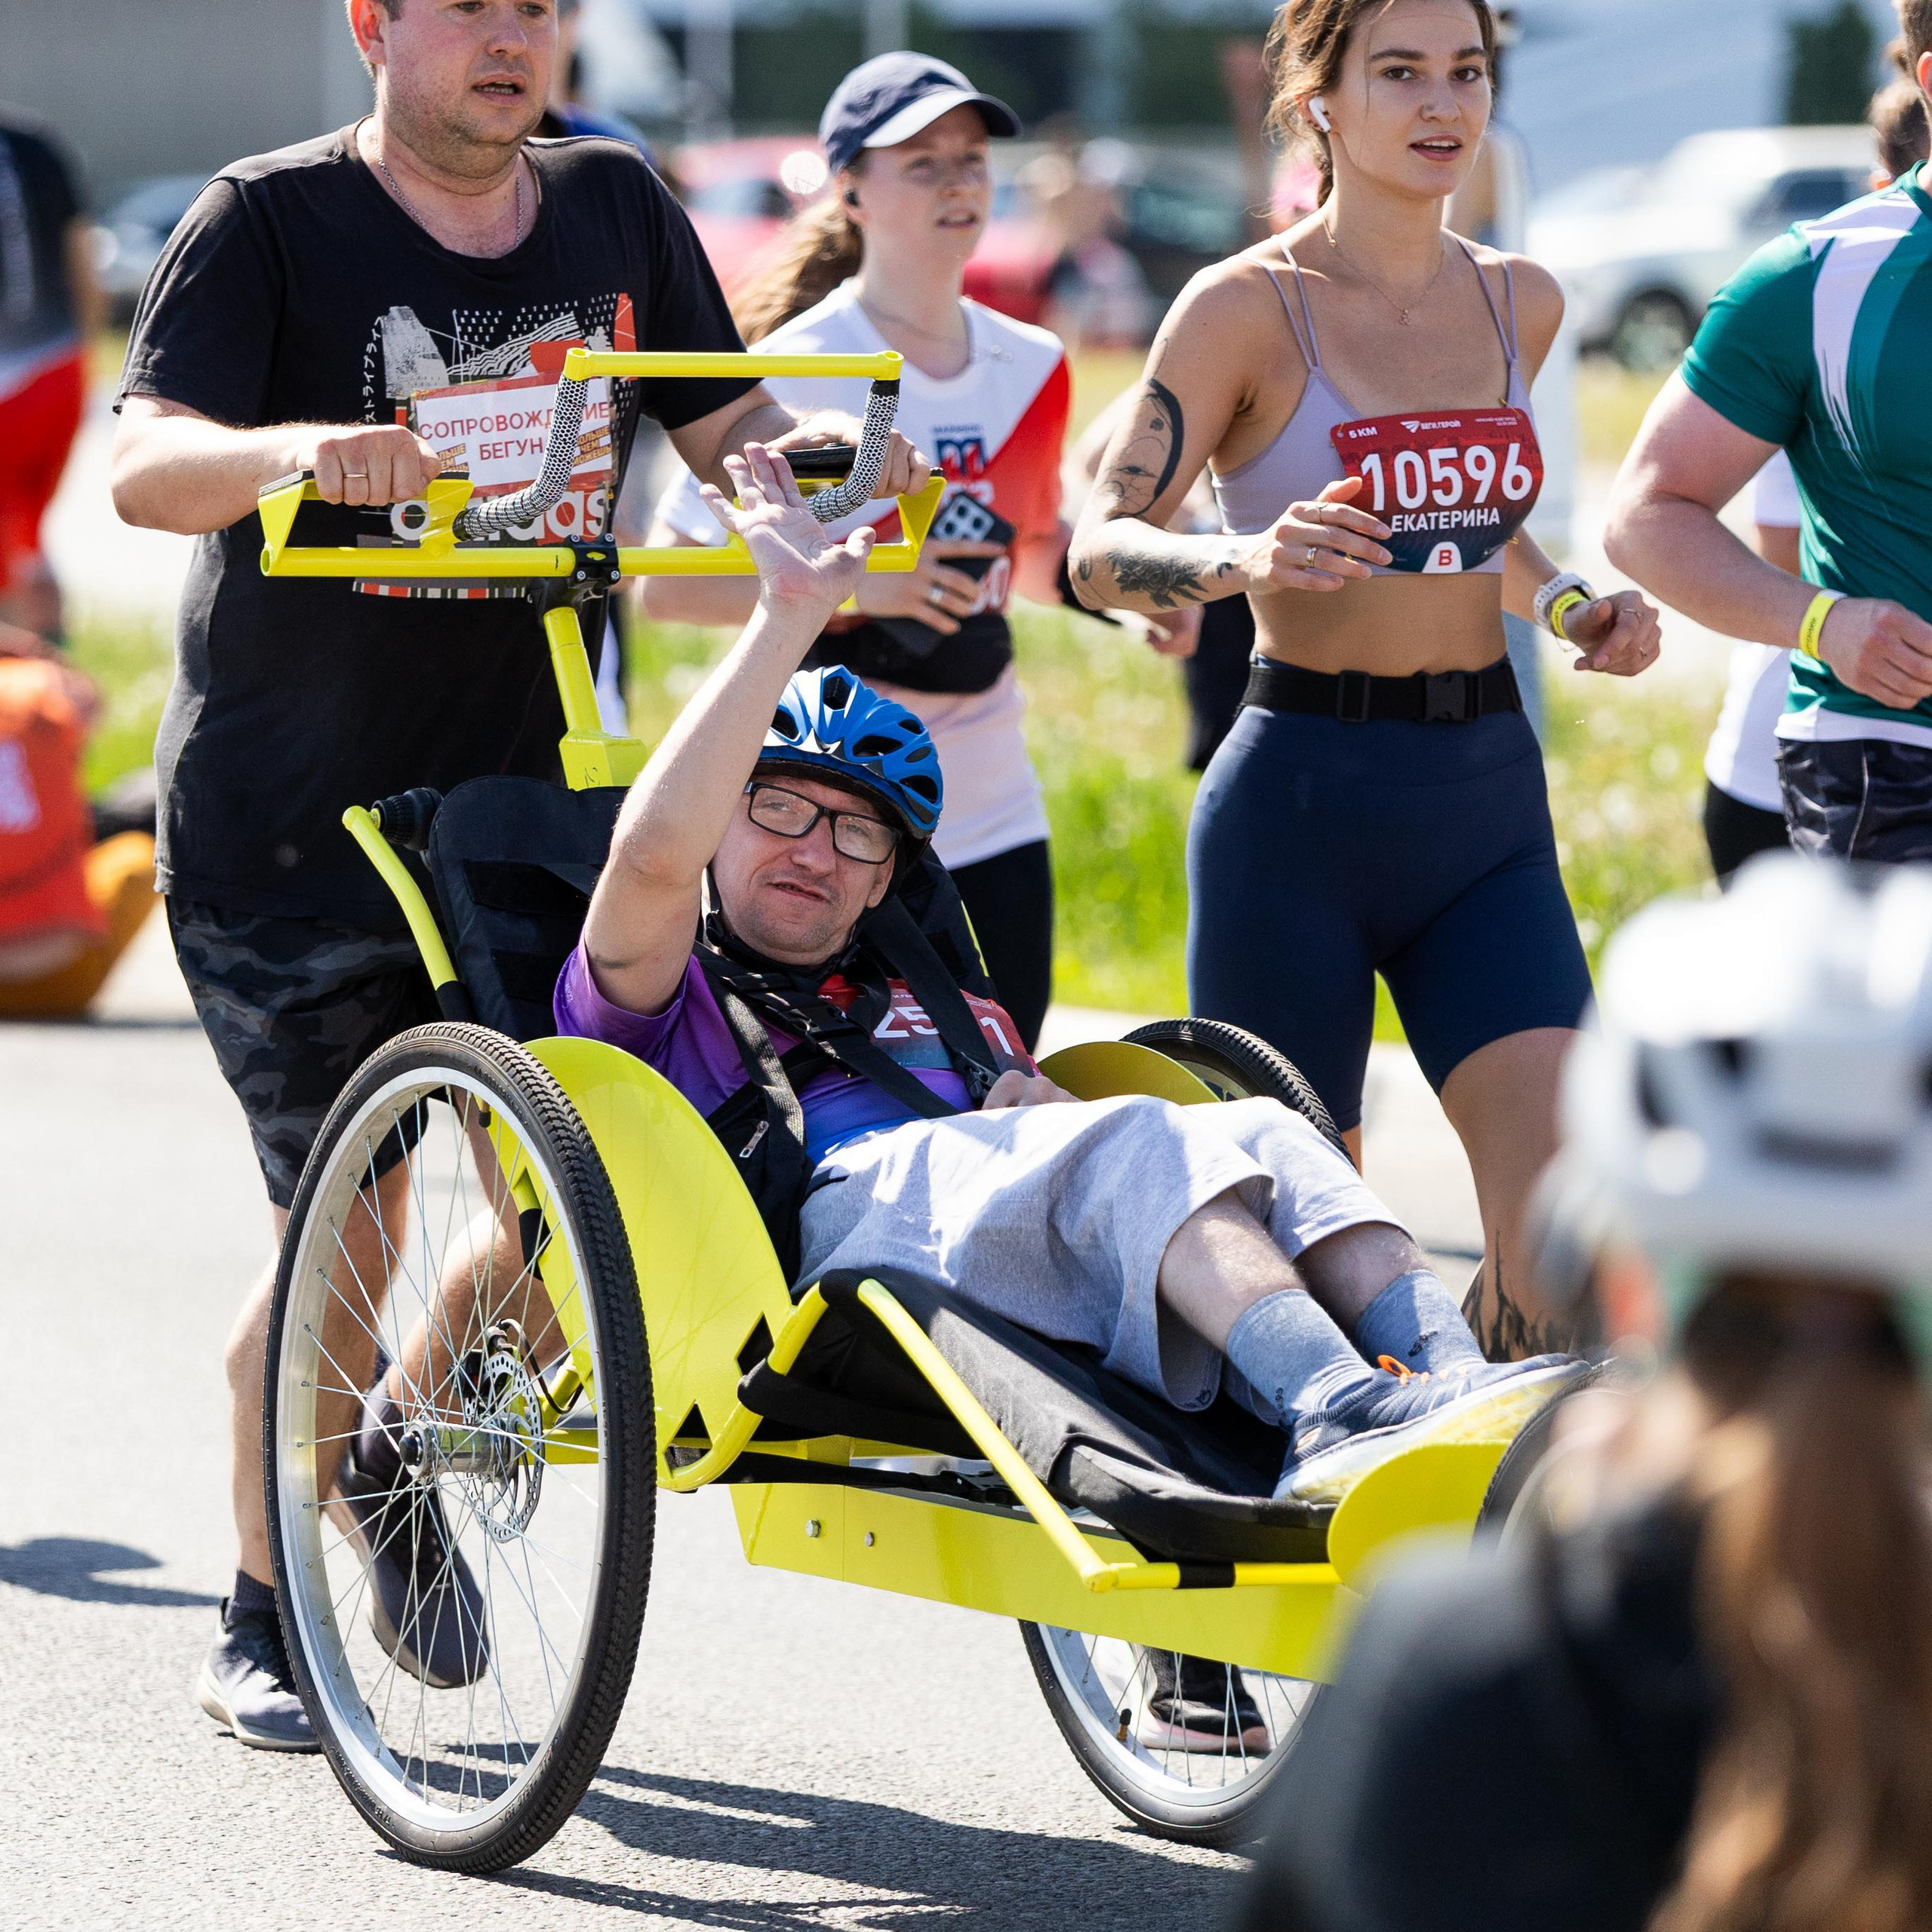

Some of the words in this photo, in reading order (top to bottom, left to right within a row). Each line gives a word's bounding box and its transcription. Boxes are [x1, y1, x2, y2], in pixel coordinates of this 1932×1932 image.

[419, 401, 610, 440] СОПРОВОЖДИЕ
[577, 424, 611, 445] ОЛЬШЕ
[1361, 442, 1533, 511] 10596
[1391, 507, 1500, 532] ЕКАТЕРИНА
